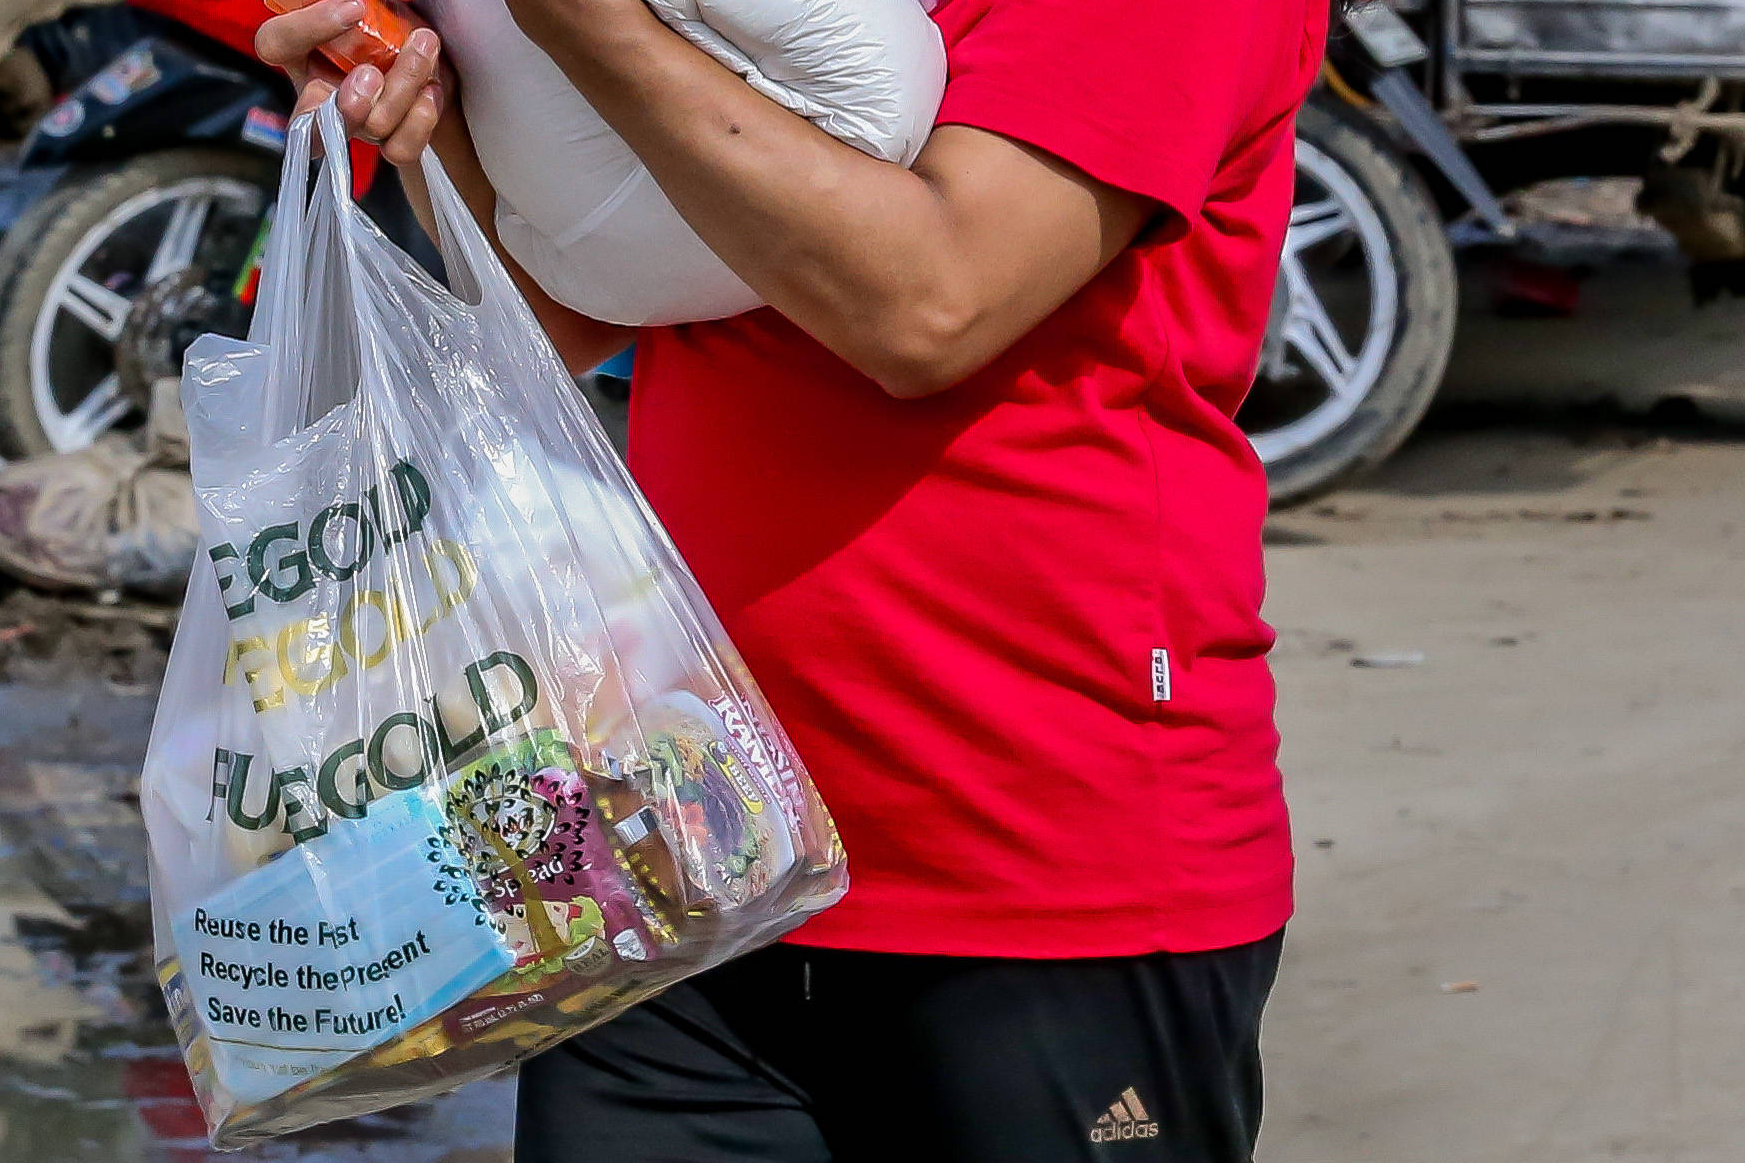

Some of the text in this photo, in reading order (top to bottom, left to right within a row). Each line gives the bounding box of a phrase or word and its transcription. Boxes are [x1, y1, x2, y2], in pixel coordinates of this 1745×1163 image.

[728, 764, 762, 803] BEEF
[491, 855, 564, 898] Spead
[194, 908, 261, 941] Reuse
[269, 918, 309, 945] the
[200, 952, 289, 990] Recycle
[297, 965, 339, 991] the
[208, 997, 261, 1028] Save
[267, 1007, 308, 1032] the
[315, 993, 408, 1035] Future!
[1091, 1120, 1159, 1144] adidas
